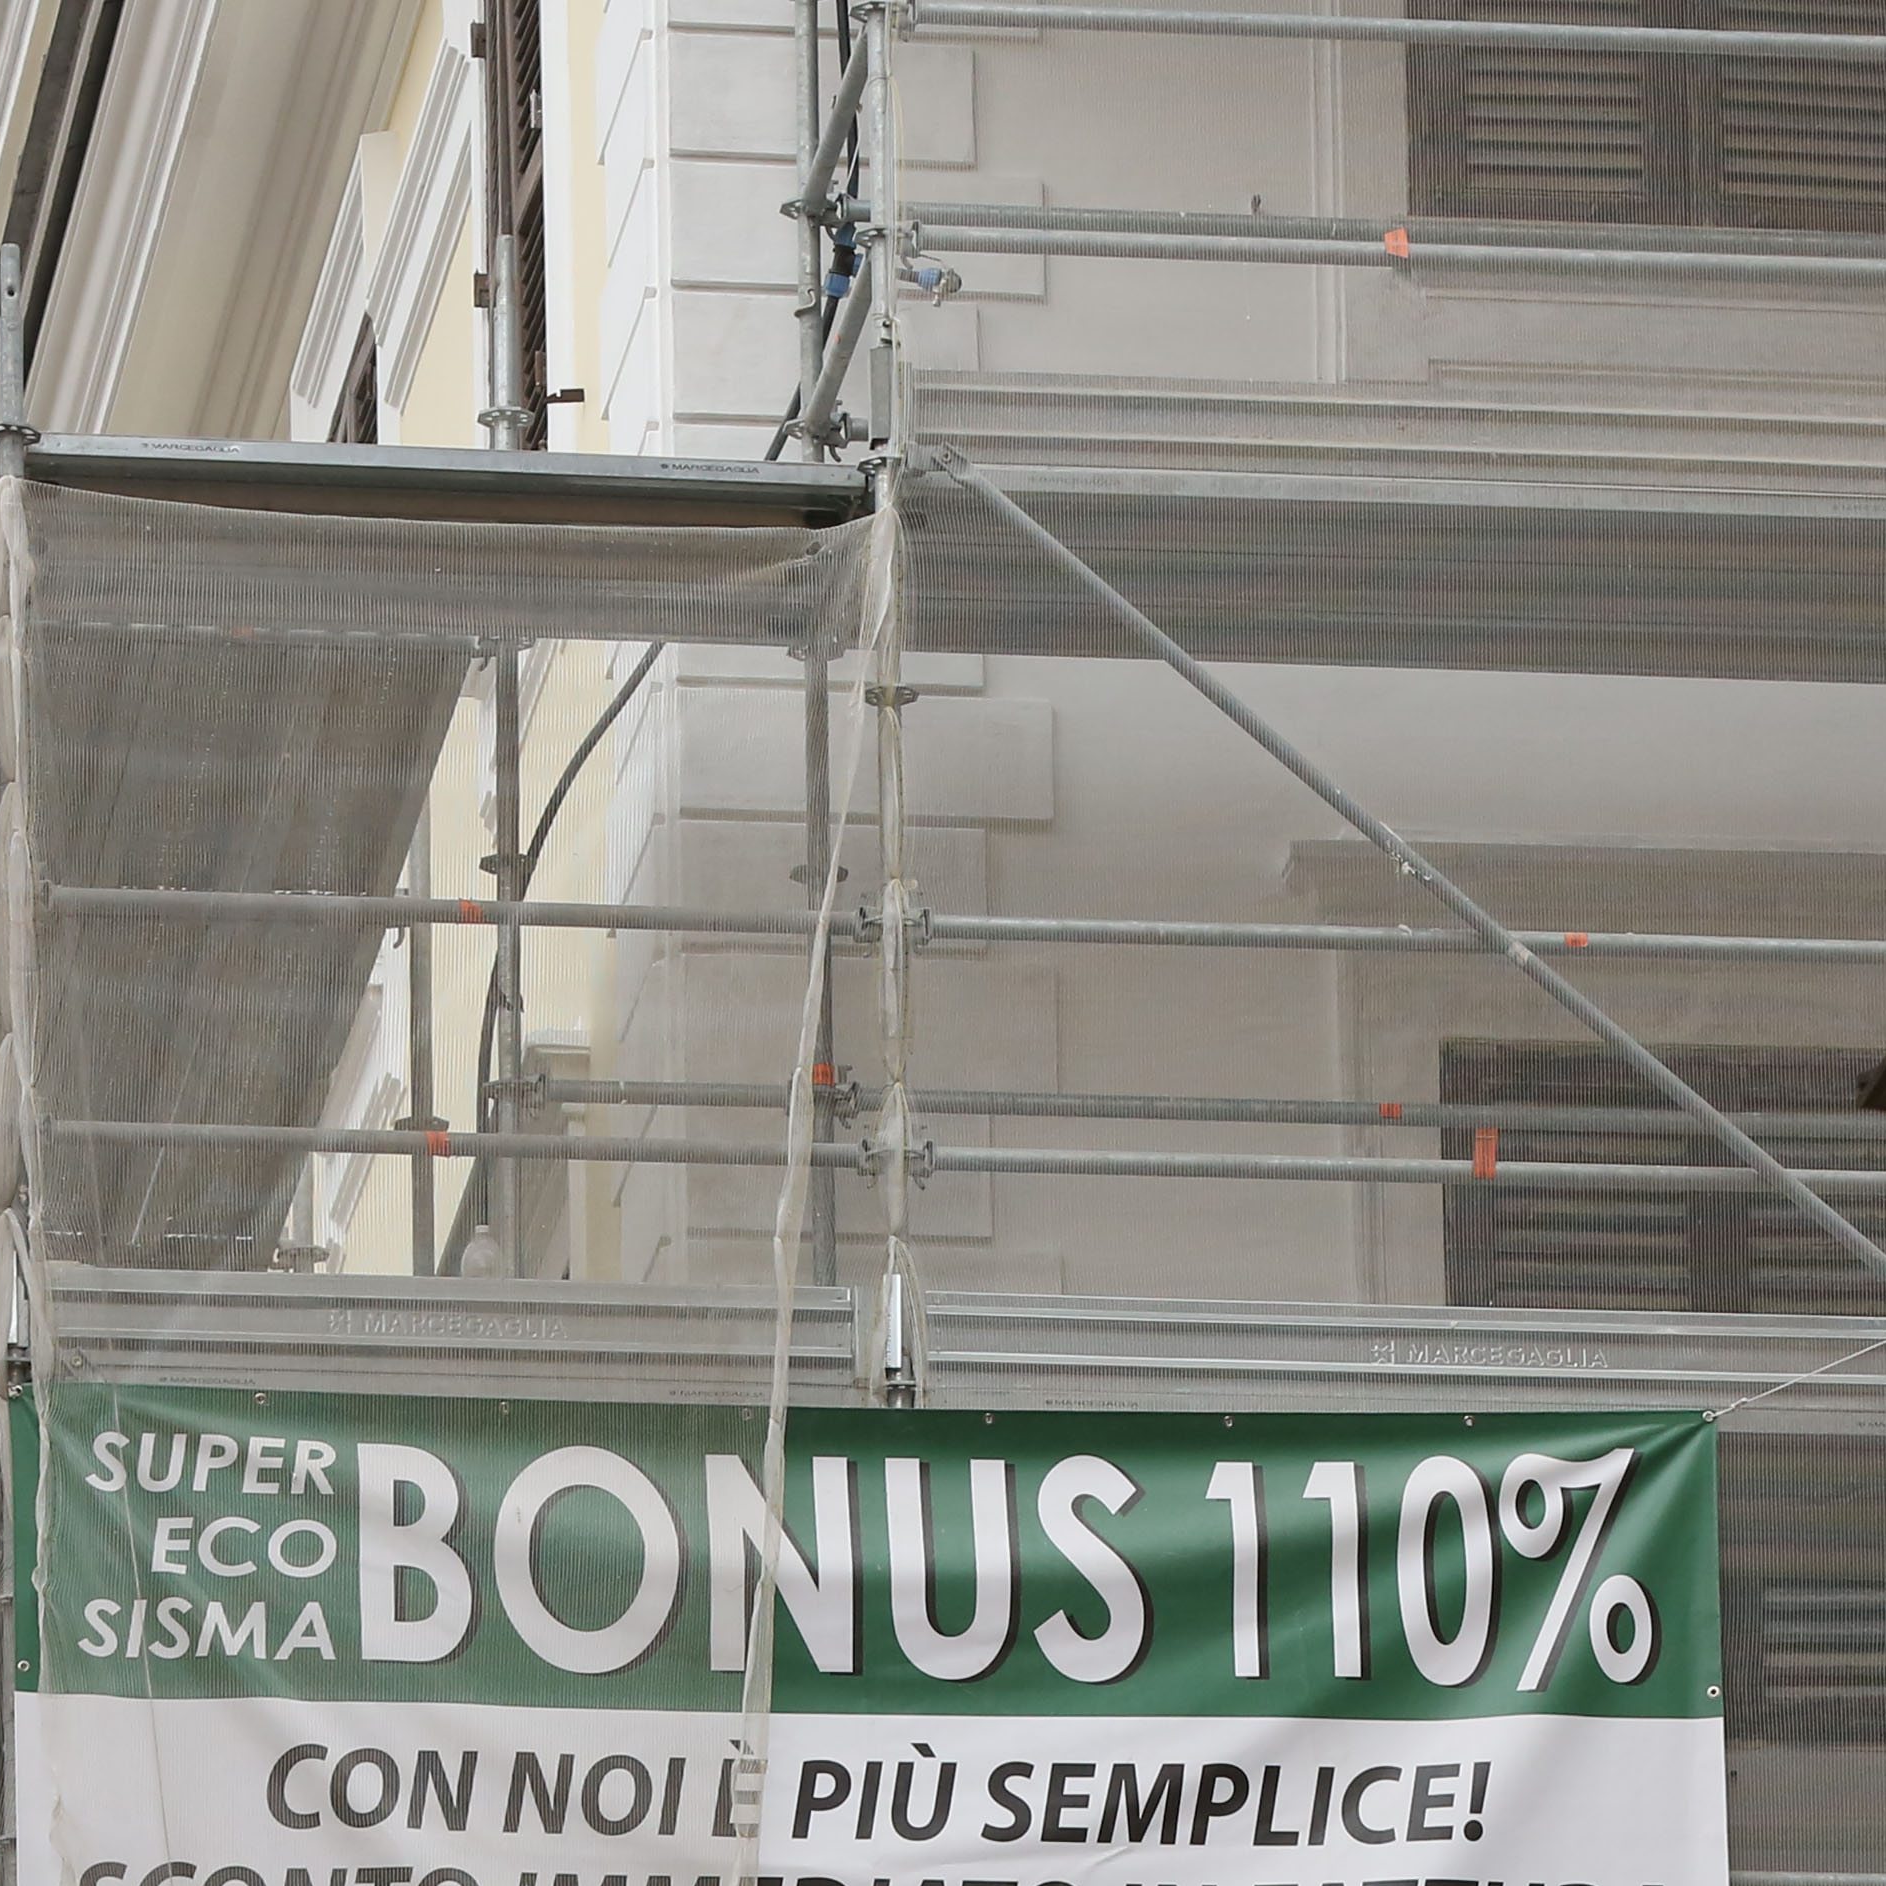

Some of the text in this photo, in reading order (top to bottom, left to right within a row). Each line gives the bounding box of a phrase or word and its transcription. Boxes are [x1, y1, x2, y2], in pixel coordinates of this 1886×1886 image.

[364, 1310, 568, 1339] MARCEGAGLIA
[1407, 1343, 1609, 1369] MARCEGAGLIA
[85, 1431, 337, 1494] SUPER
[152, 1516, 337, 1578] ECO
[357, 1443, 1655, 1692] BONUS 110%
[79, 1597, 336, 1660] SISMA
[266, 1739, 1489, 1846] CON NOI È PIÙ SEMPLICE!
